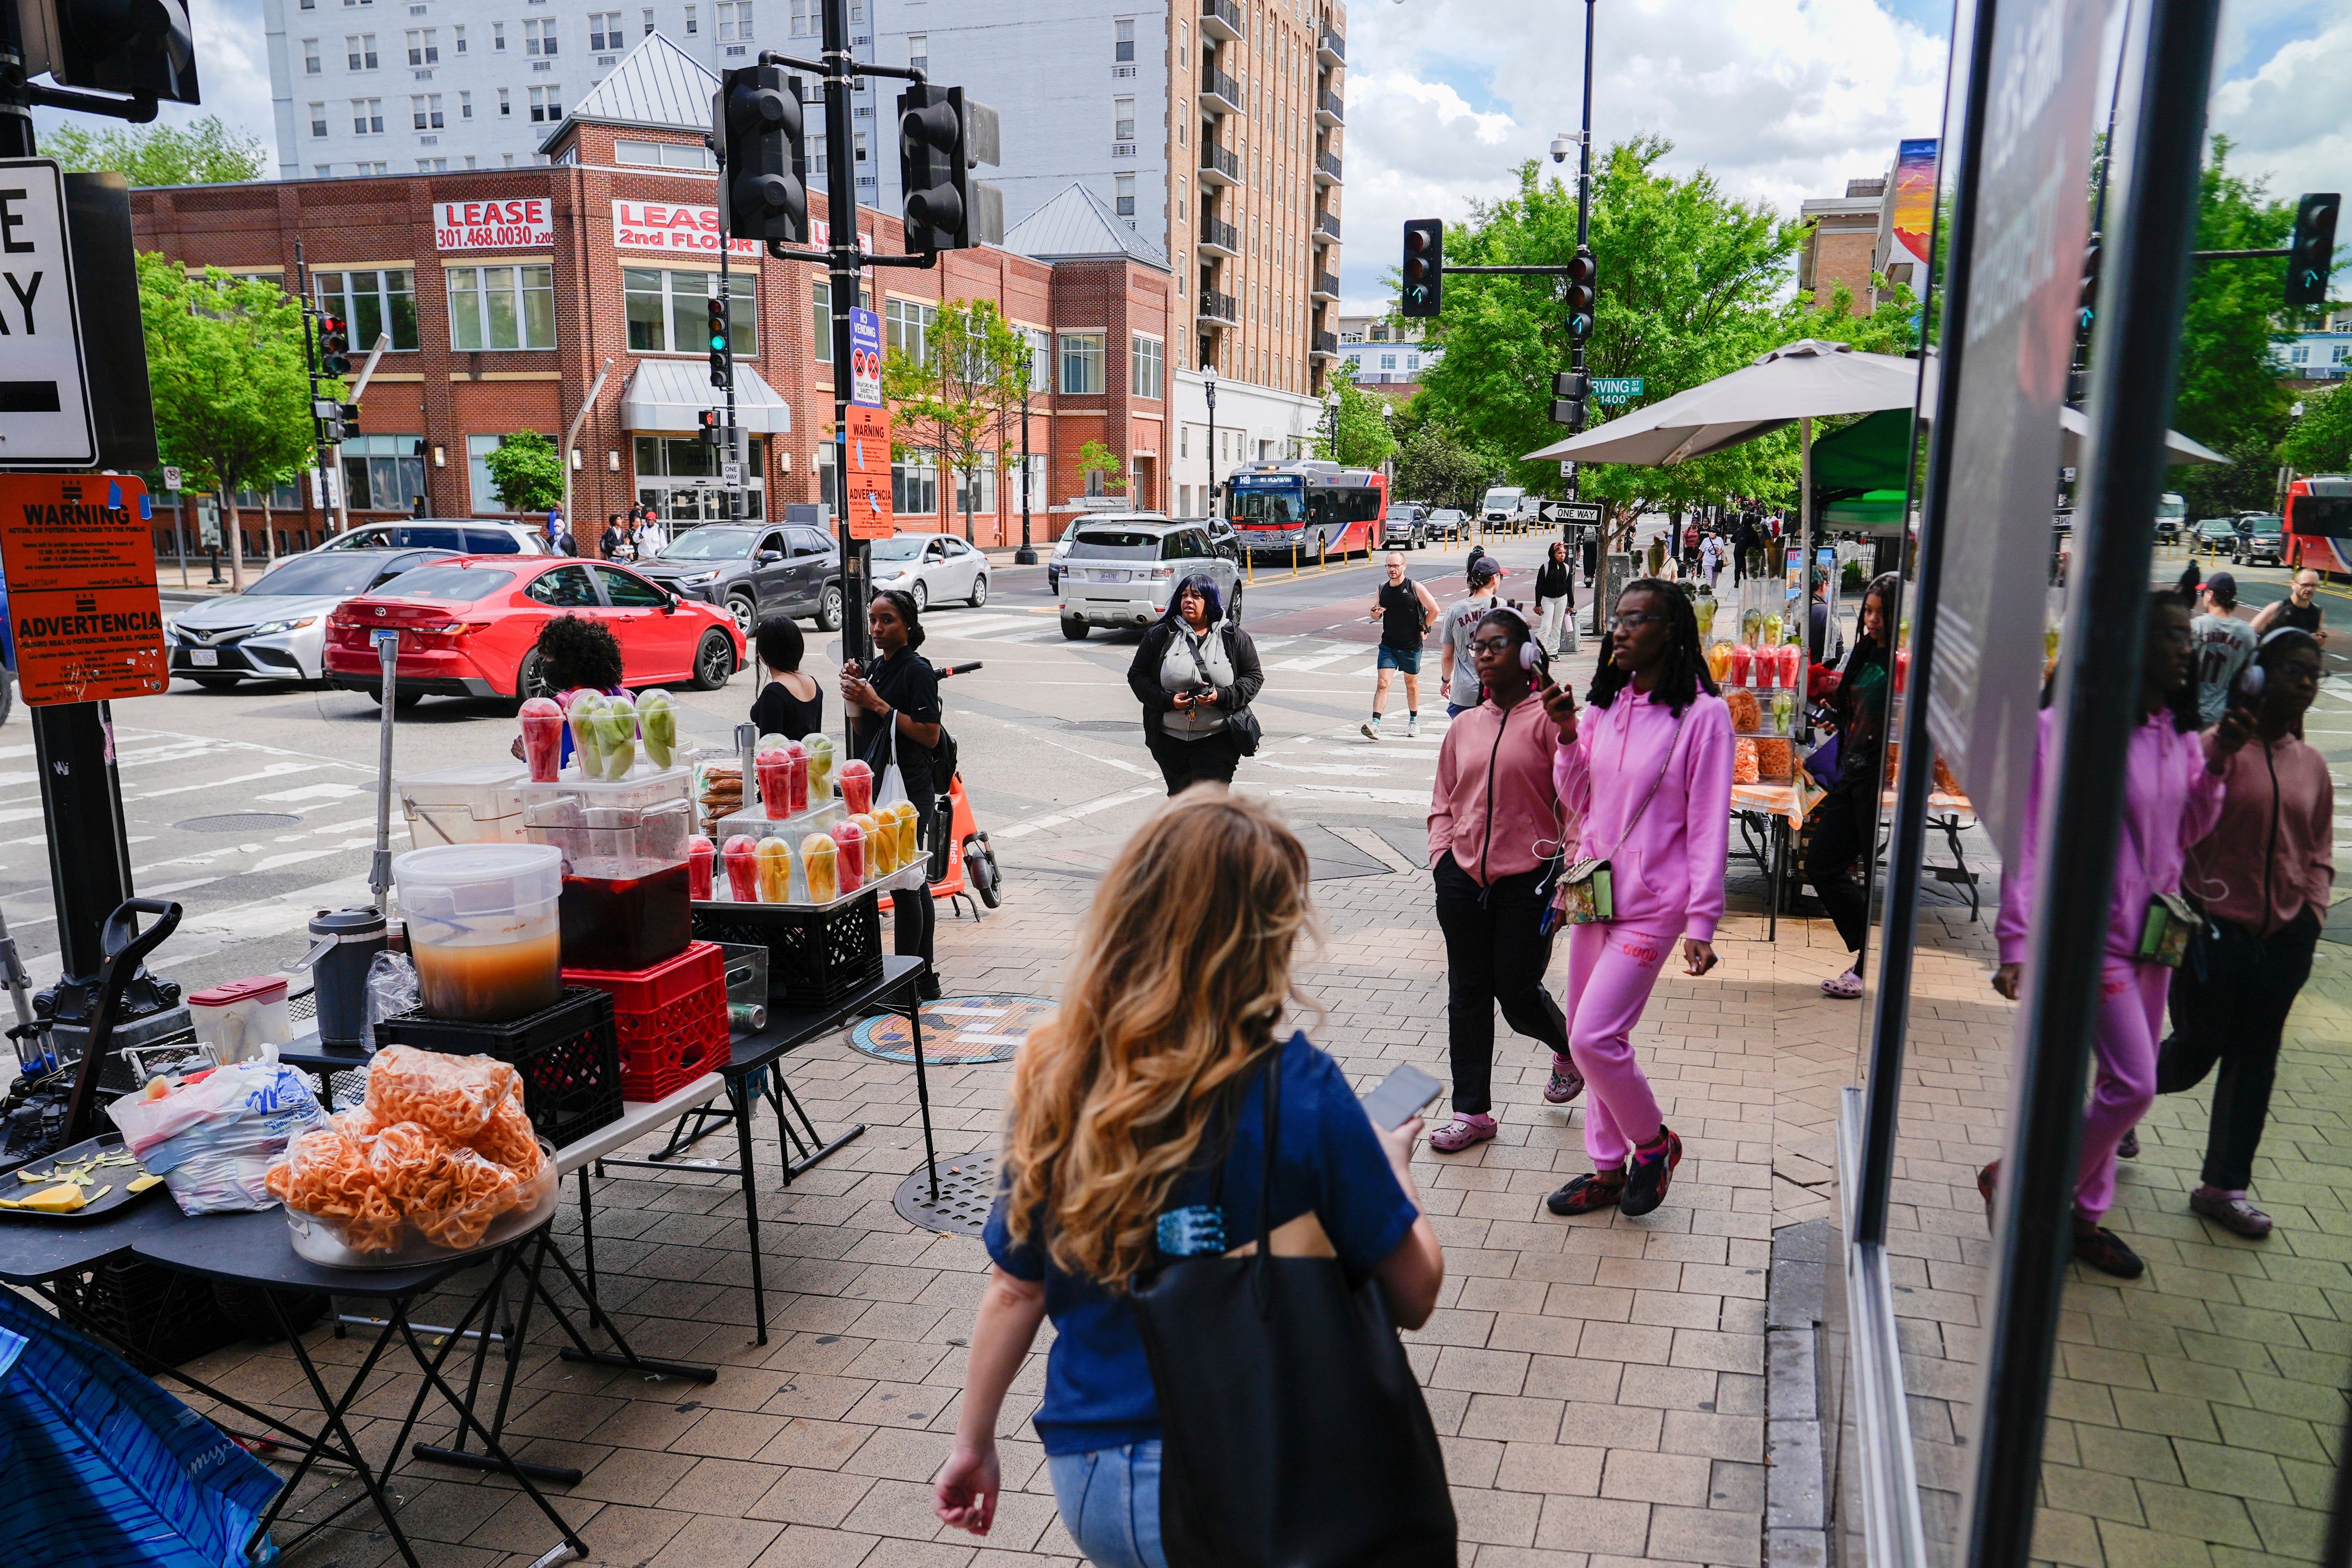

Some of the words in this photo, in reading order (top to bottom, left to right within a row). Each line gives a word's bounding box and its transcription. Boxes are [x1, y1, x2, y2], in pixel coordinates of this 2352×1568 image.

[447, 201, 543, 227] LEASE
[621, 205, 730, 233] LEAS
[438, 226, 532, 247] 301.468.0030
[619, 229, 664, 246] 2nd
[672, 233, 754, 252] FLOOR
[0, 271, 43, 335] Y
[860, 312, 868, 324] NO
[854, 322, 876, 338] VENDING
[1591, 380, 1629, 393] RVING
[1600, 395, 1626, 404] 1400
[853, 423, 884, 438] WARNING
[23, 504, 130, 525] WARNING
[1558, 509, 1574, 517] ONE
[1577, 510, 1595, 519] WAY
[19, 611, 162, 638] ADVERTENCIA
[950, 840, 958, 864] SPIN
[1623, 943, 1658, 962] GOOD
